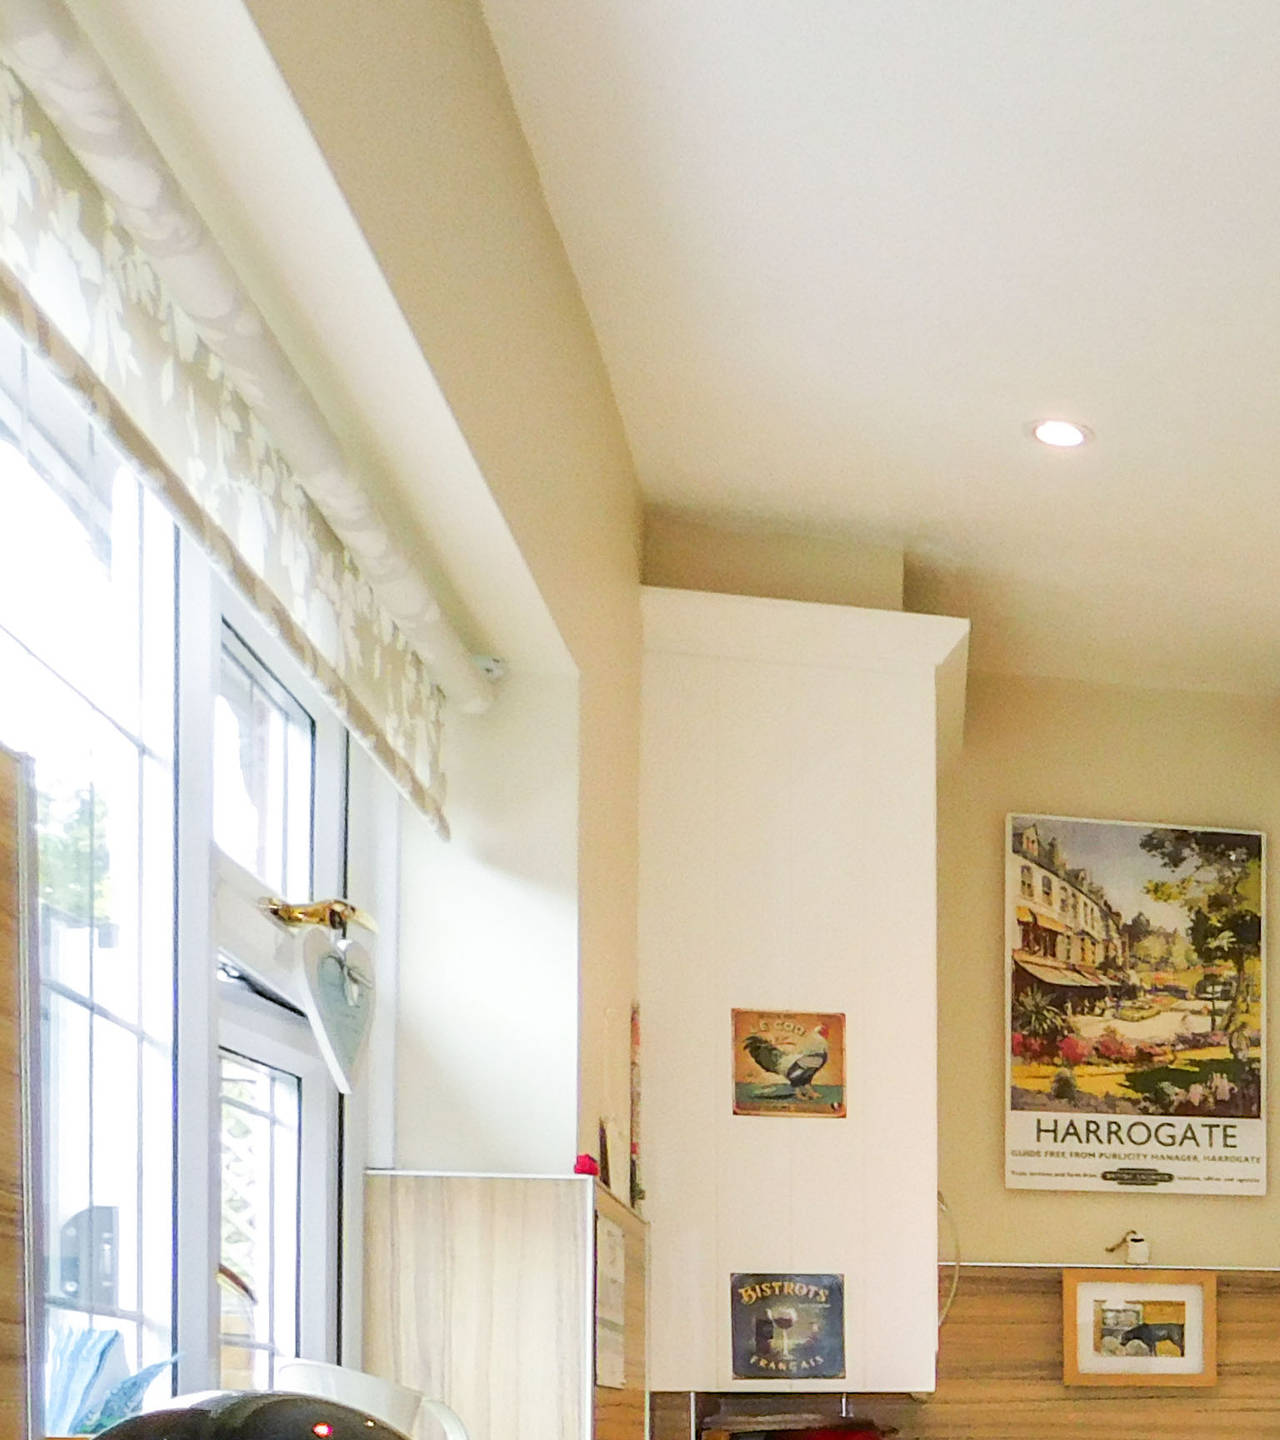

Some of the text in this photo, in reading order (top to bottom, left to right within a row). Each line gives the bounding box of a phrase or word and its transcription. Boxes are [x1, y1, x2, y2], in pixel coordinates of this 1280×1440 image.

[1036, 1118, 1238, 1148] HARROGATE
[1010, 1149, 1041, 1158] GUIDE
[1044, 1150, 1066, 1159] FREE
[1069, 1151, 1096, 1160] FROM
[1098, 1152, 1148, 1160] PUBLICITY
[1202, 1154, 1261, 1164] HARROGATE
[738, 1281, 829, 1305] BISTROTS
